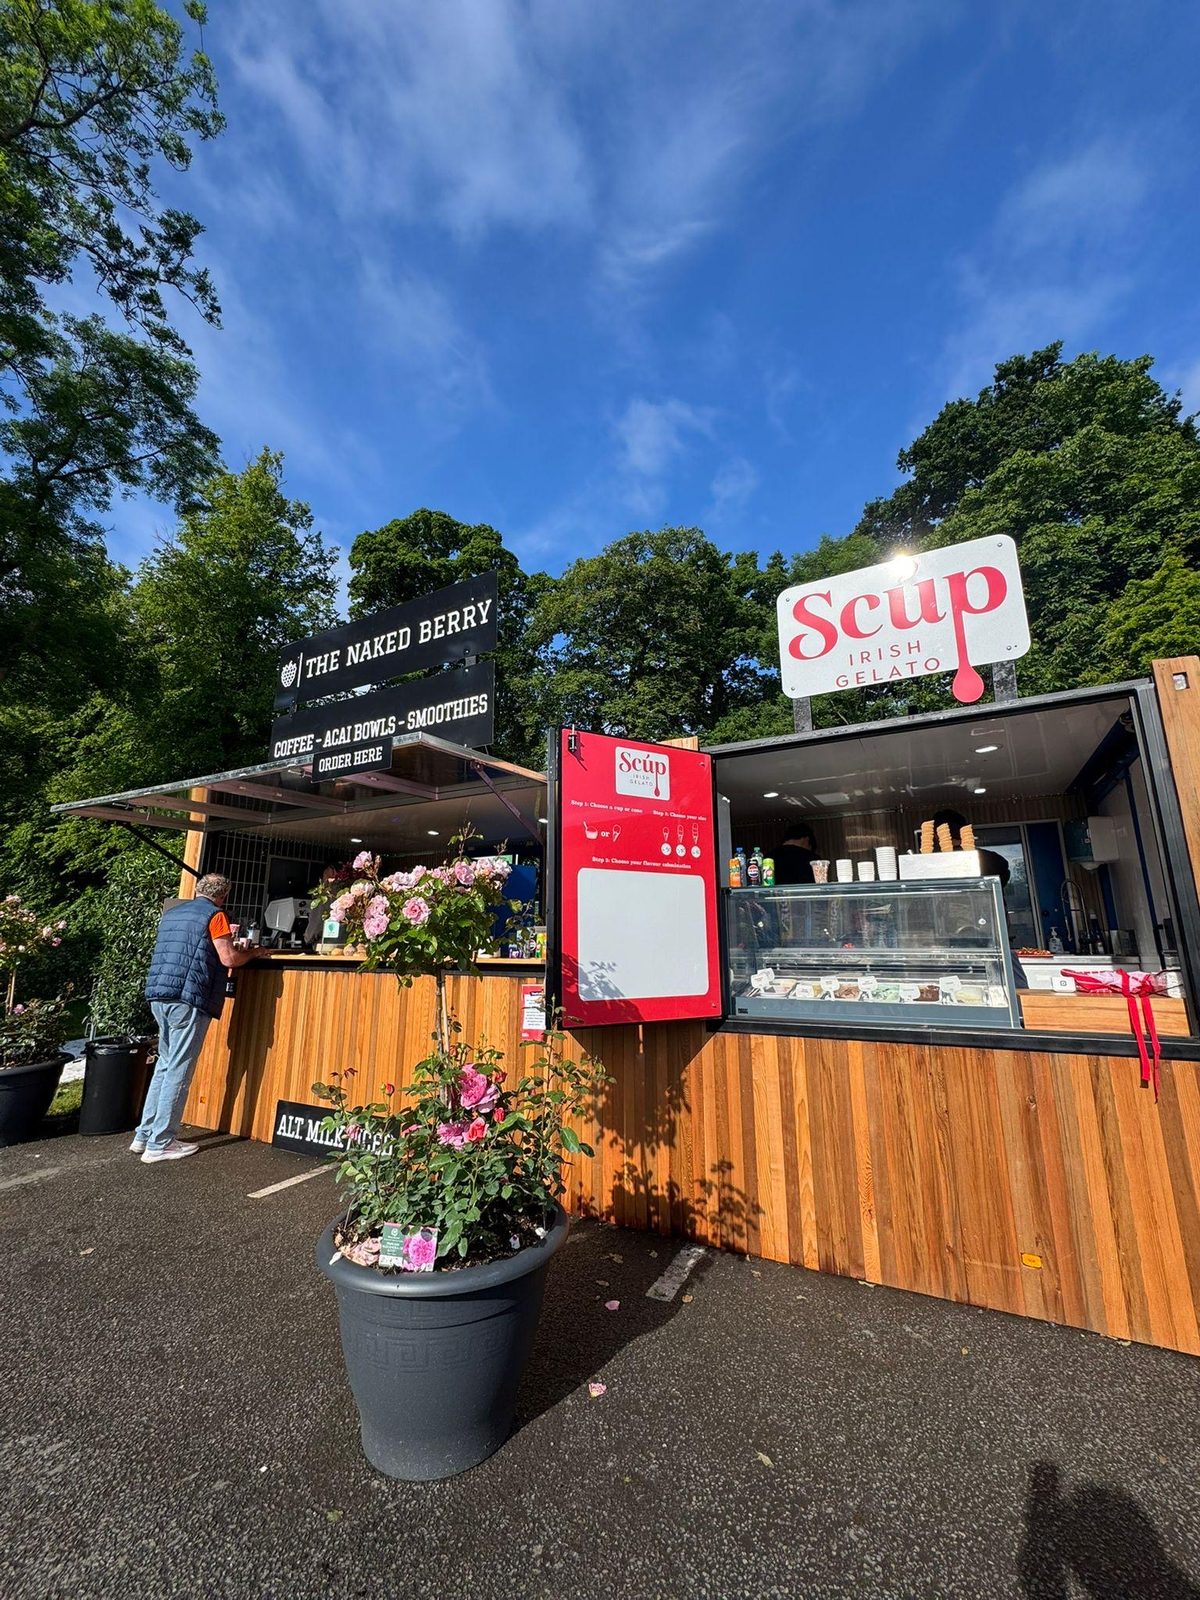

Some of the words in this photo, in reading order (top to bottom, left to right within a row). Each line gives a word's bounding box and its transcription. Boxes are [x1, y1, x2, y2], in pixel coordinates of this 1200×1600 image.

[306, 650, 340, 679] THE
[346, 627, 411, 667] NAKED
[418, 599, 492, 645] BERRY
[849, 640, 922, 666] IRISH
[835, 657, 941, 688] GELATO
[274, 734, 314, 758] COFFEE
[323, 725, 351, 748] ACAI
[353, 715, 397, 743] BOWLS
[407, 693, 488, 731] SMOOTHIES
[318, 753, 352, 772] ORDER
[353, 746, 384, 767] HERE
[619, 751, 666, 797] Scúp
